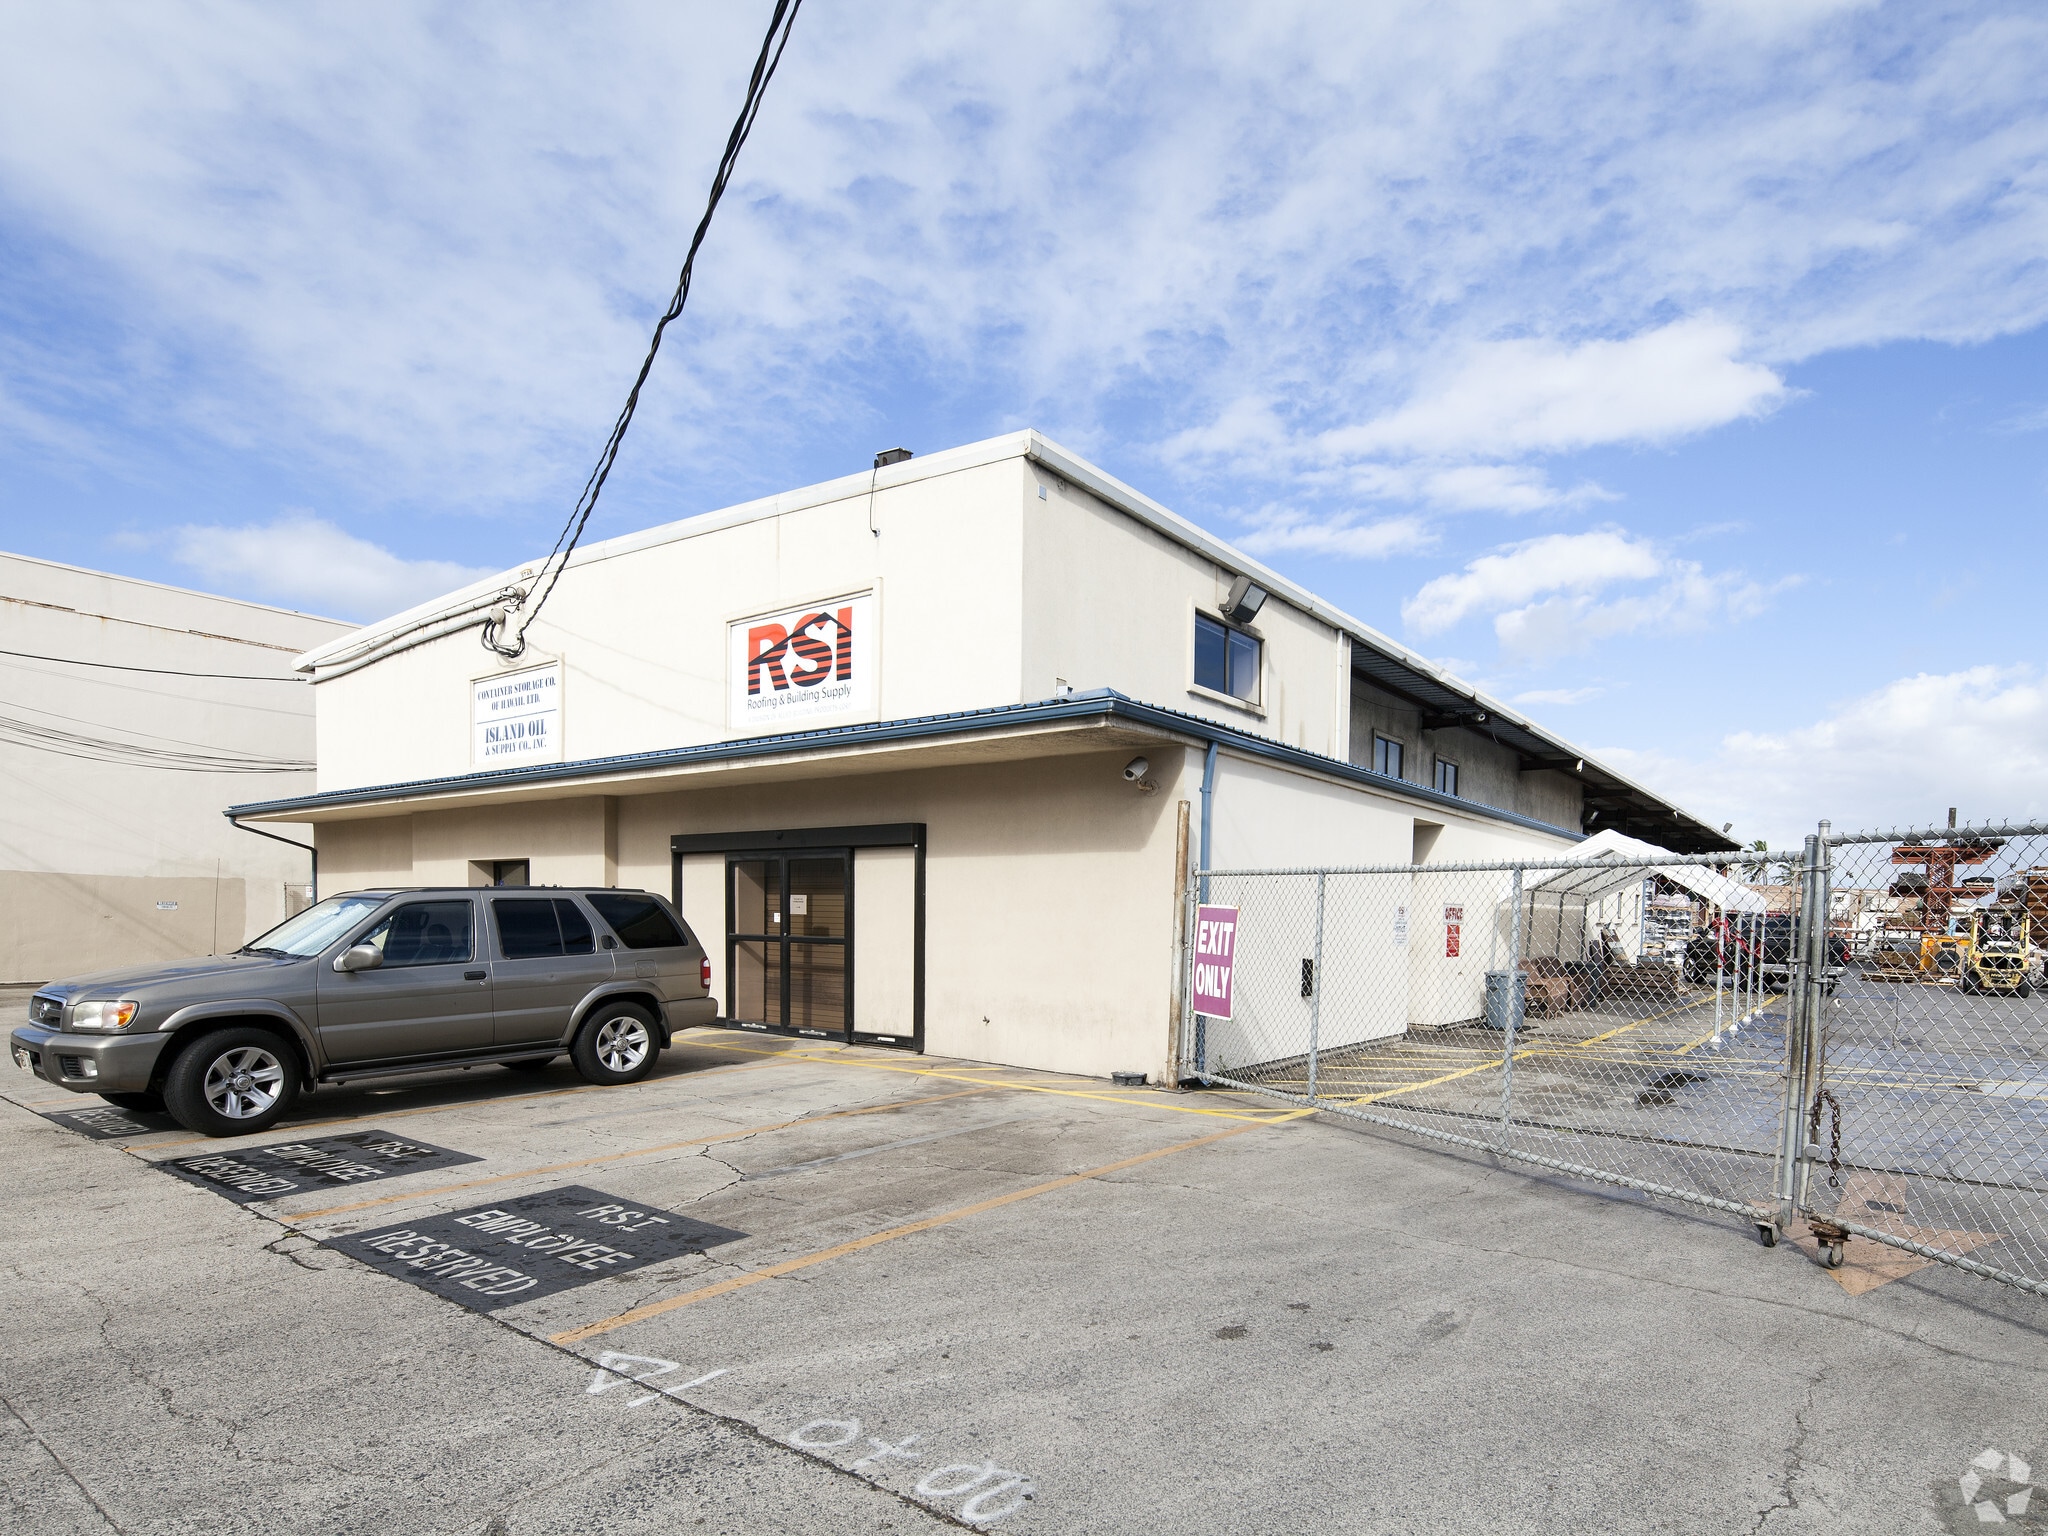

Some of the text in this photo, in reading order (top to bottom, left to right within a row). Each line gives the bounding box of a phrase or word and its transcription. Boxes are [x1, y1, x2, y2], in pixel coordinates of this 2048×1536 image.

[748, 606, 853, 695] RSI
[478, 676, 556, 701] CONTAINER STORAGE CO.
[491, 700, 499, 711] OF
[527, 693, 541, 704] LTD.
[747, 683, 852, 710] Roofing & Building Supply
[485, 719, 547, 744] ISLAND OIL
[485, 746, 490, 756] &
[491, 741, 516, 755] SUPPLY
[533, 737, 547, 750] INC.
[1198, 920, 1234, 957] EXIT
[1195, 962, 1231, 999] ONLY
[179, 1156, 299, 1195] RESERVED
[263, 1144, 386, 1181] EMPLOYEE
[454, 1209, 636, 1270] EMPLOYEE
[360, 1230, 539, 1295] RESERVED
